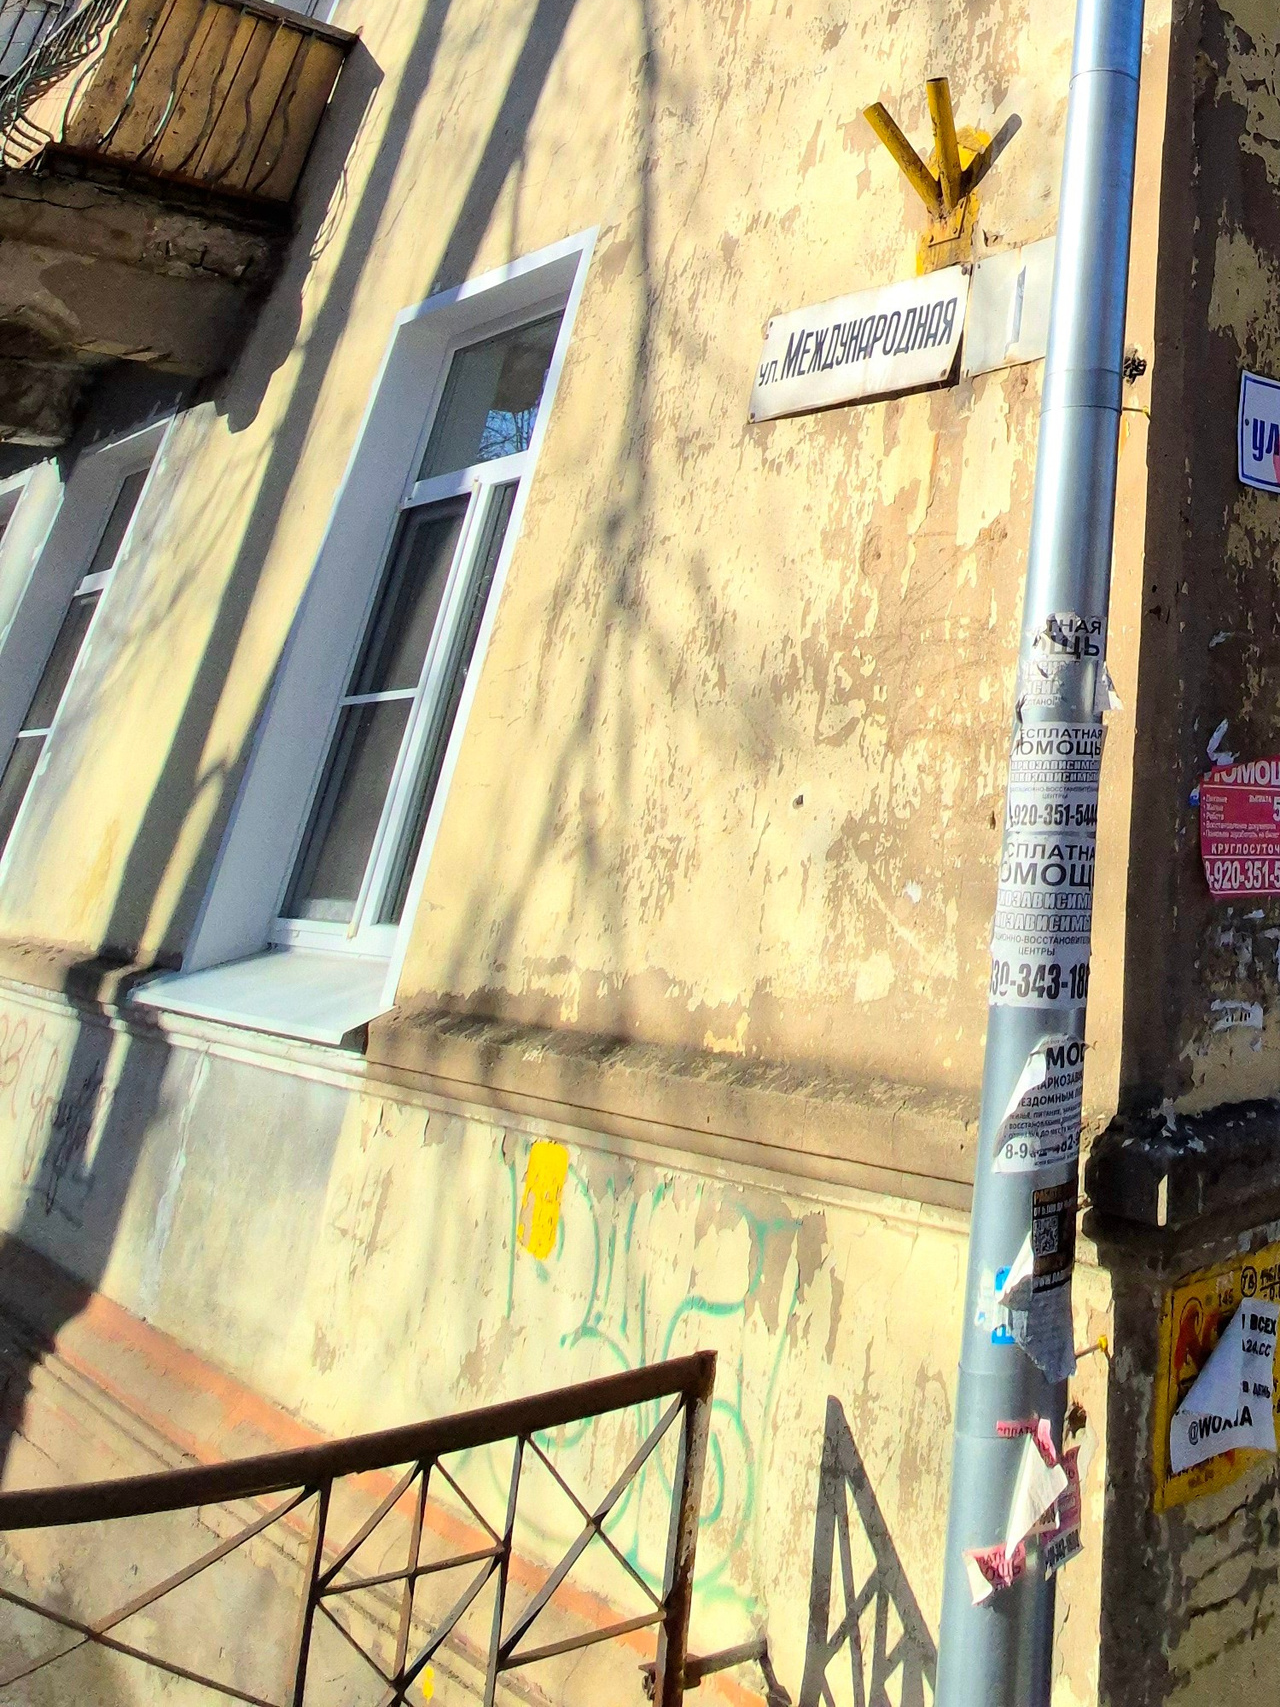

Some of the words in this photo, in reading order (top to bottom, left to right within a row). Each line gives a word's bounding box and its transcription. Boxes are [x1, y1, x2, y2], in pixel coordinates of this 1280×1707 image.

[758, 360, 779, 387] ул.
[780, 297, 958, 381] МЕЖДУНАРОДНАЯ
[1018, 728, 1103, 740] ЕСПЛАТНАЯ
[1018, 946, 1056, 957] ЦЕНТРЫ
[989, 959, 1090, 1000] 30-343-18
